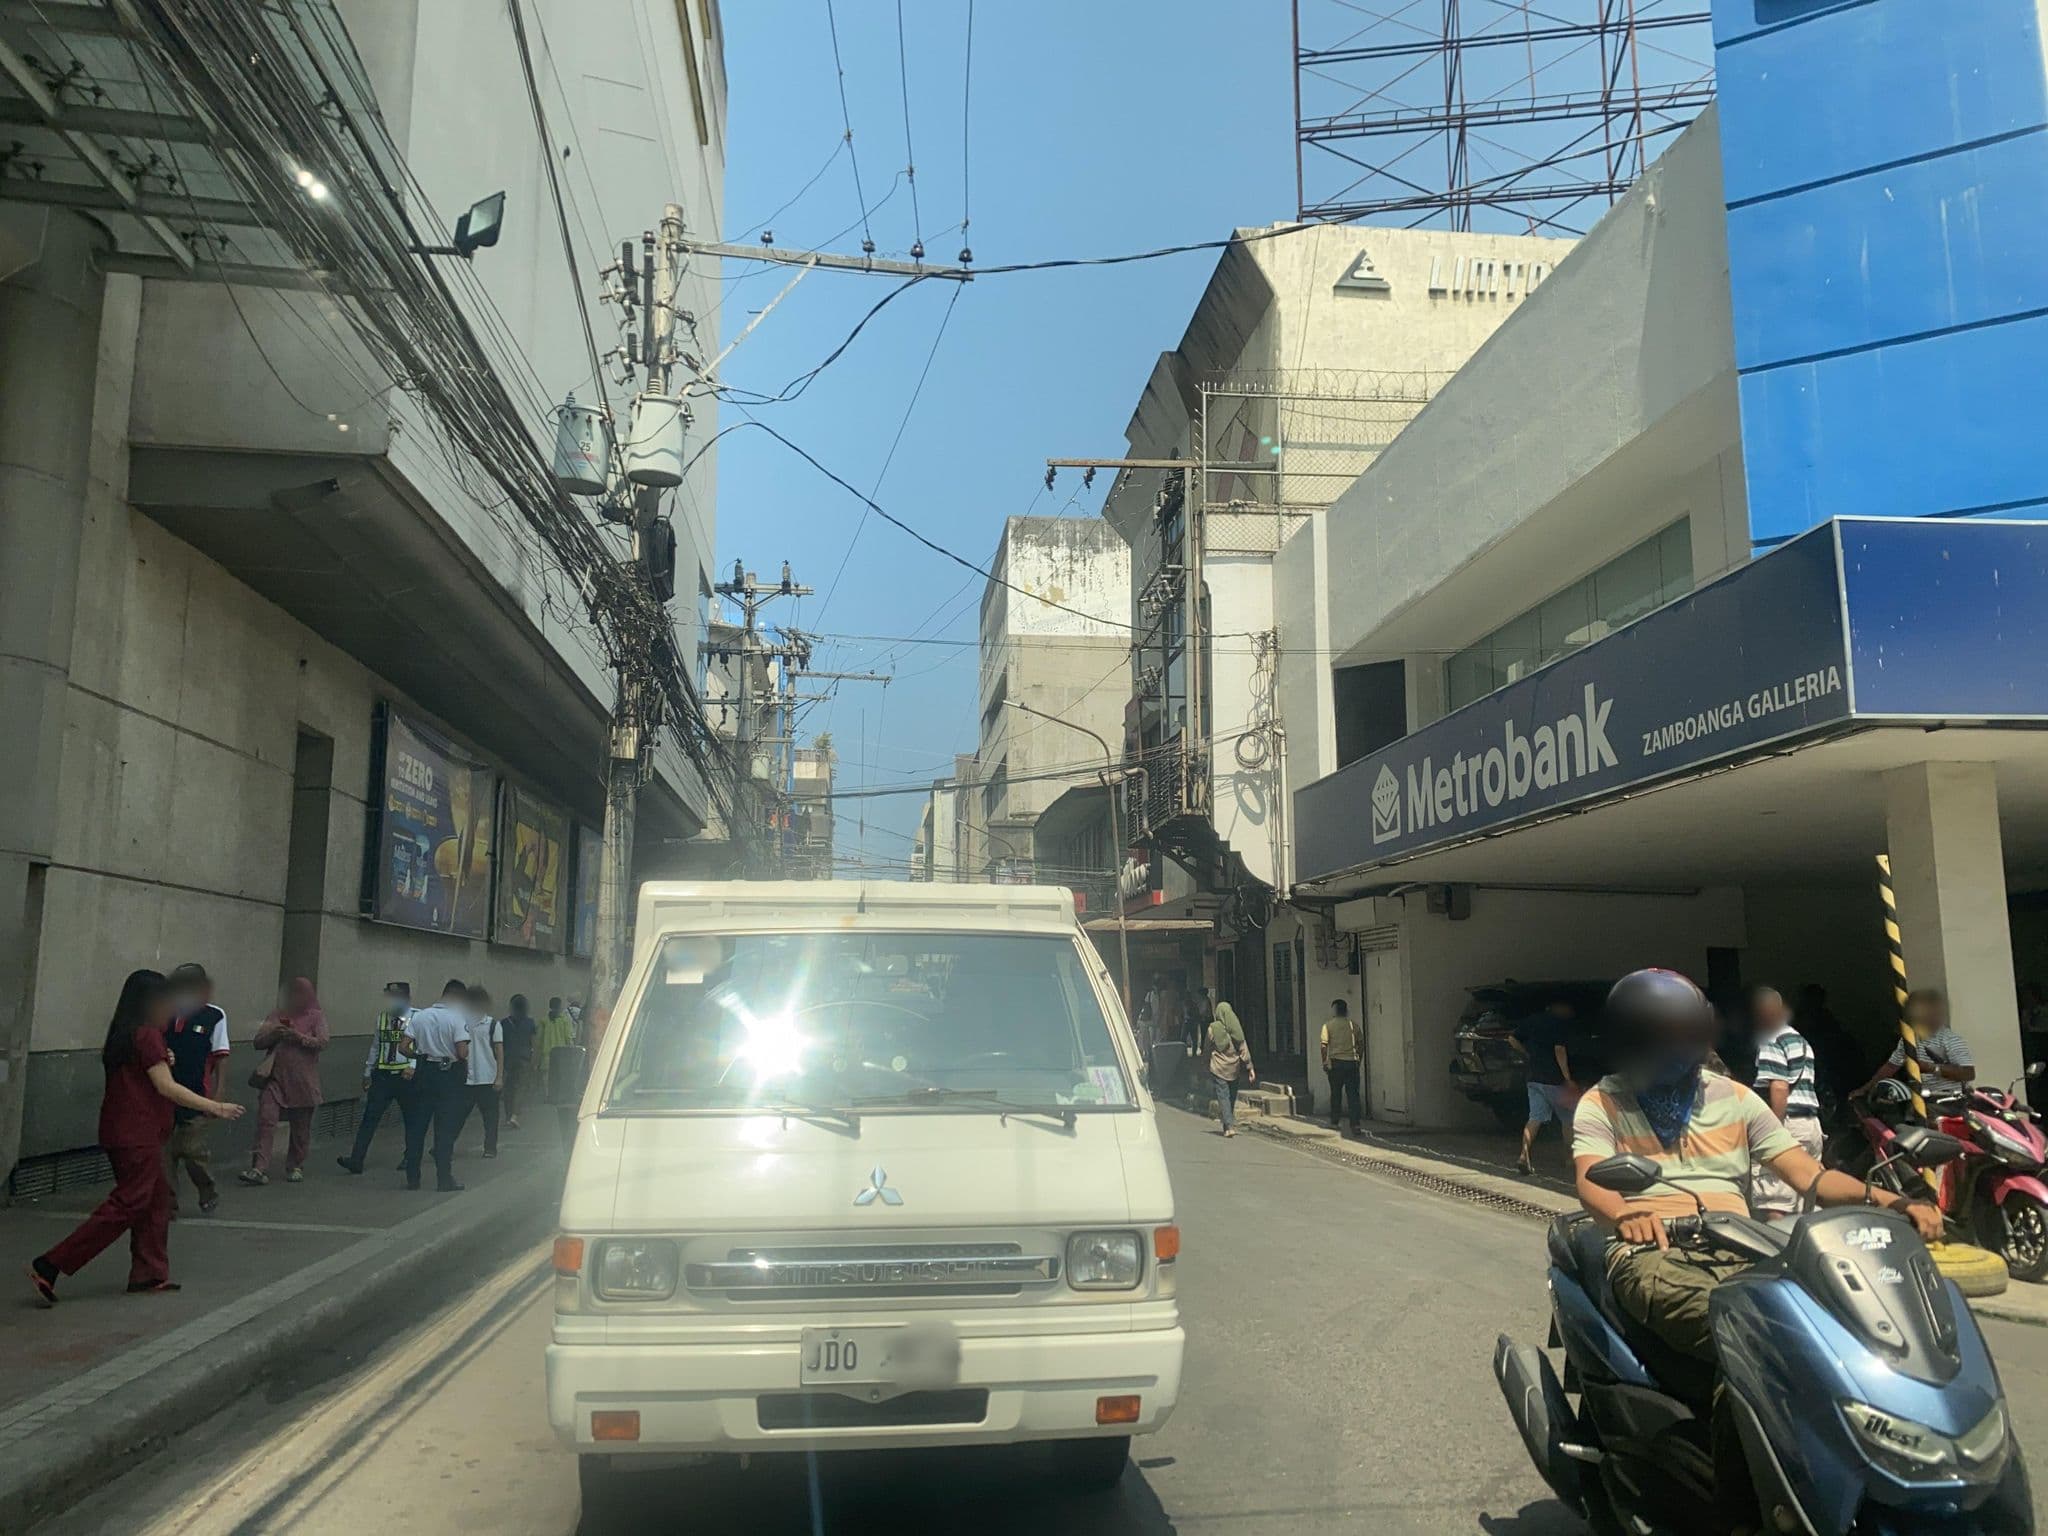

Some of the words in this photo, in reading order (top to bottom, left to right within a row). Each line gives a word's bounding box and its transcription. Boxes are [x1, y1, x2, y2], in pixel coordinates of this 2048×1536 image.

[580, 441, 591, 452] 25
[1643, 703, 1744, 756] ZAMBOANGA
[1748, 666, 1841, 719] GALLERIA
[1407, 682, 1619, 833] Metrobank
[771, 1261, 989, 1284] MITSUBISHI
[1864, 1415, 1923, 1449] illest
